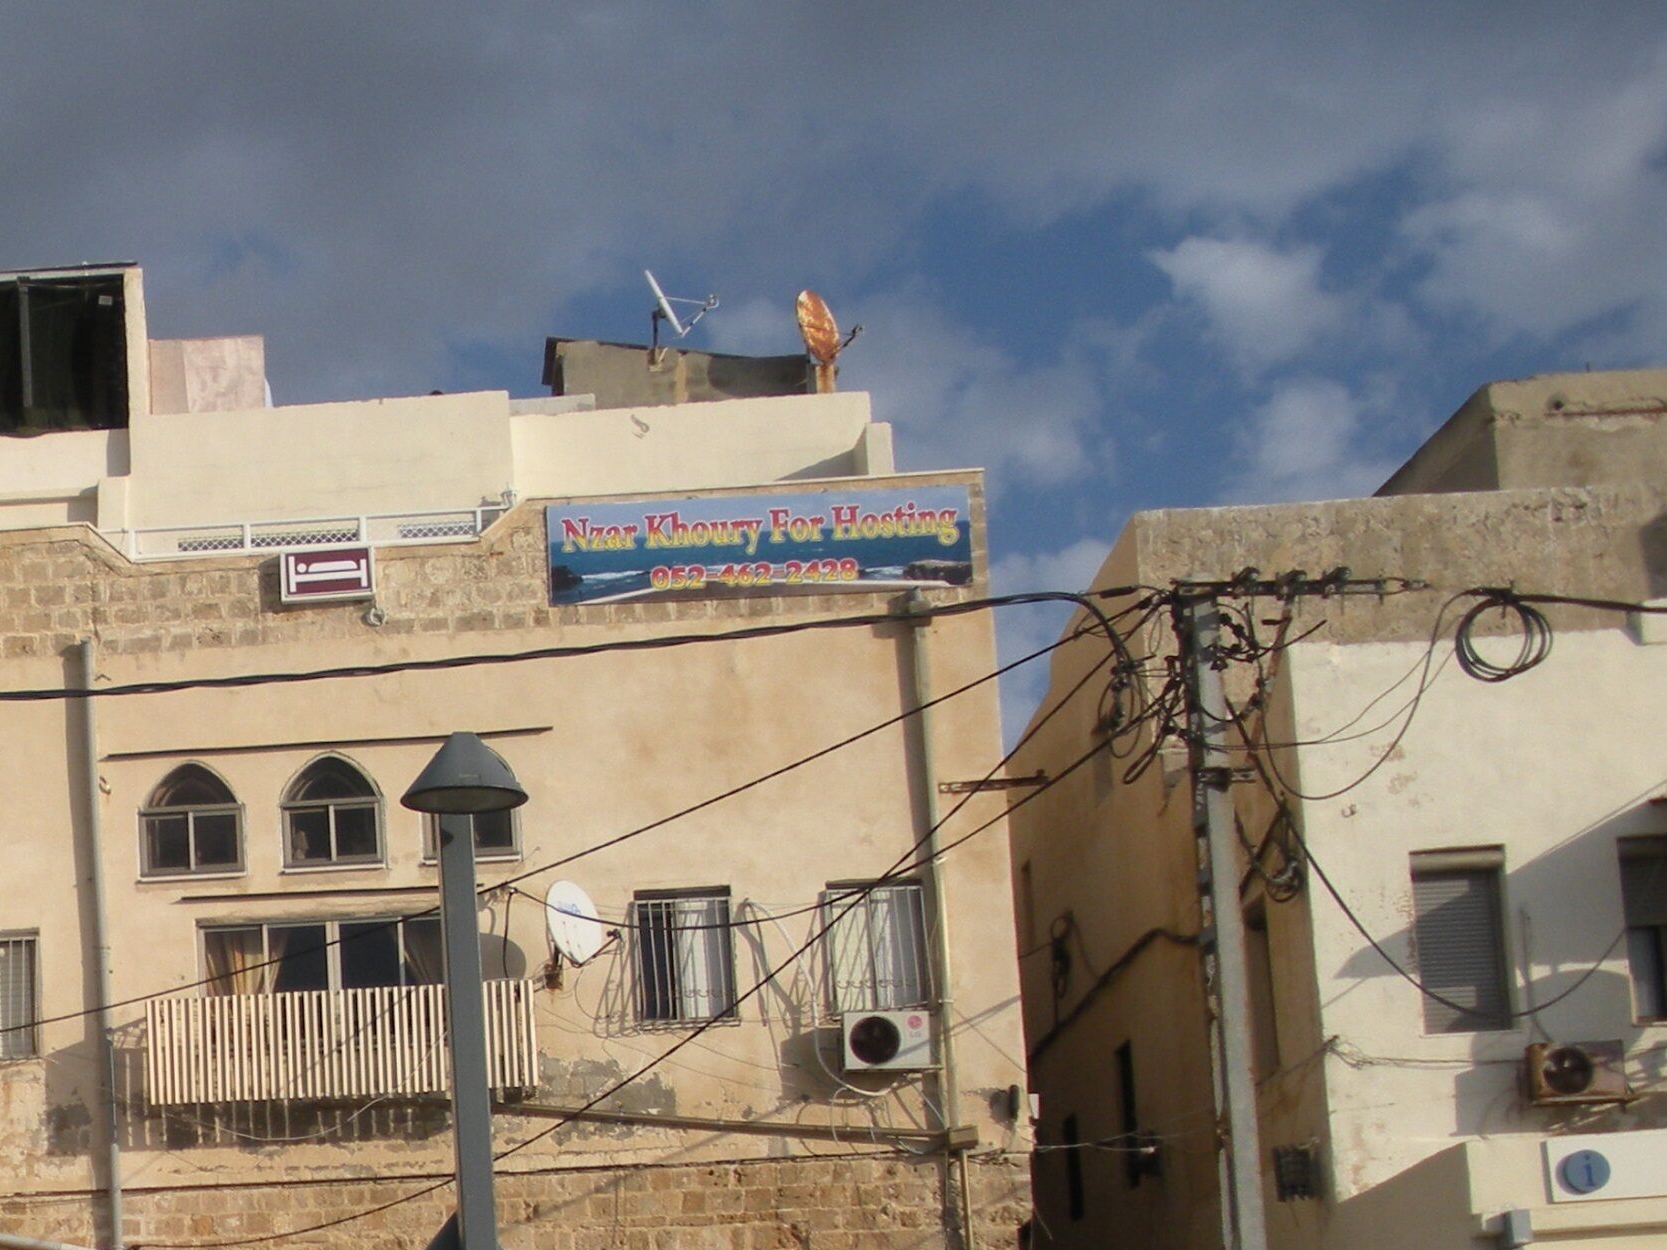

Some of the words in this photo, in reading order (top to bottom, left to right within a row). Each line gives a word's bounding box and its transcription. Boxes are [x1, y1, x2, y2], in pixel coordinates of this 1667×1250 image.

[561, 517, 638, 552] Nzar
[644, 512, 763, 555] Khoury
[769, 508, 825, 543] For
[831, 502, 960, 546] Hosting
[650, 558, 859, 591] 052-462-2428
